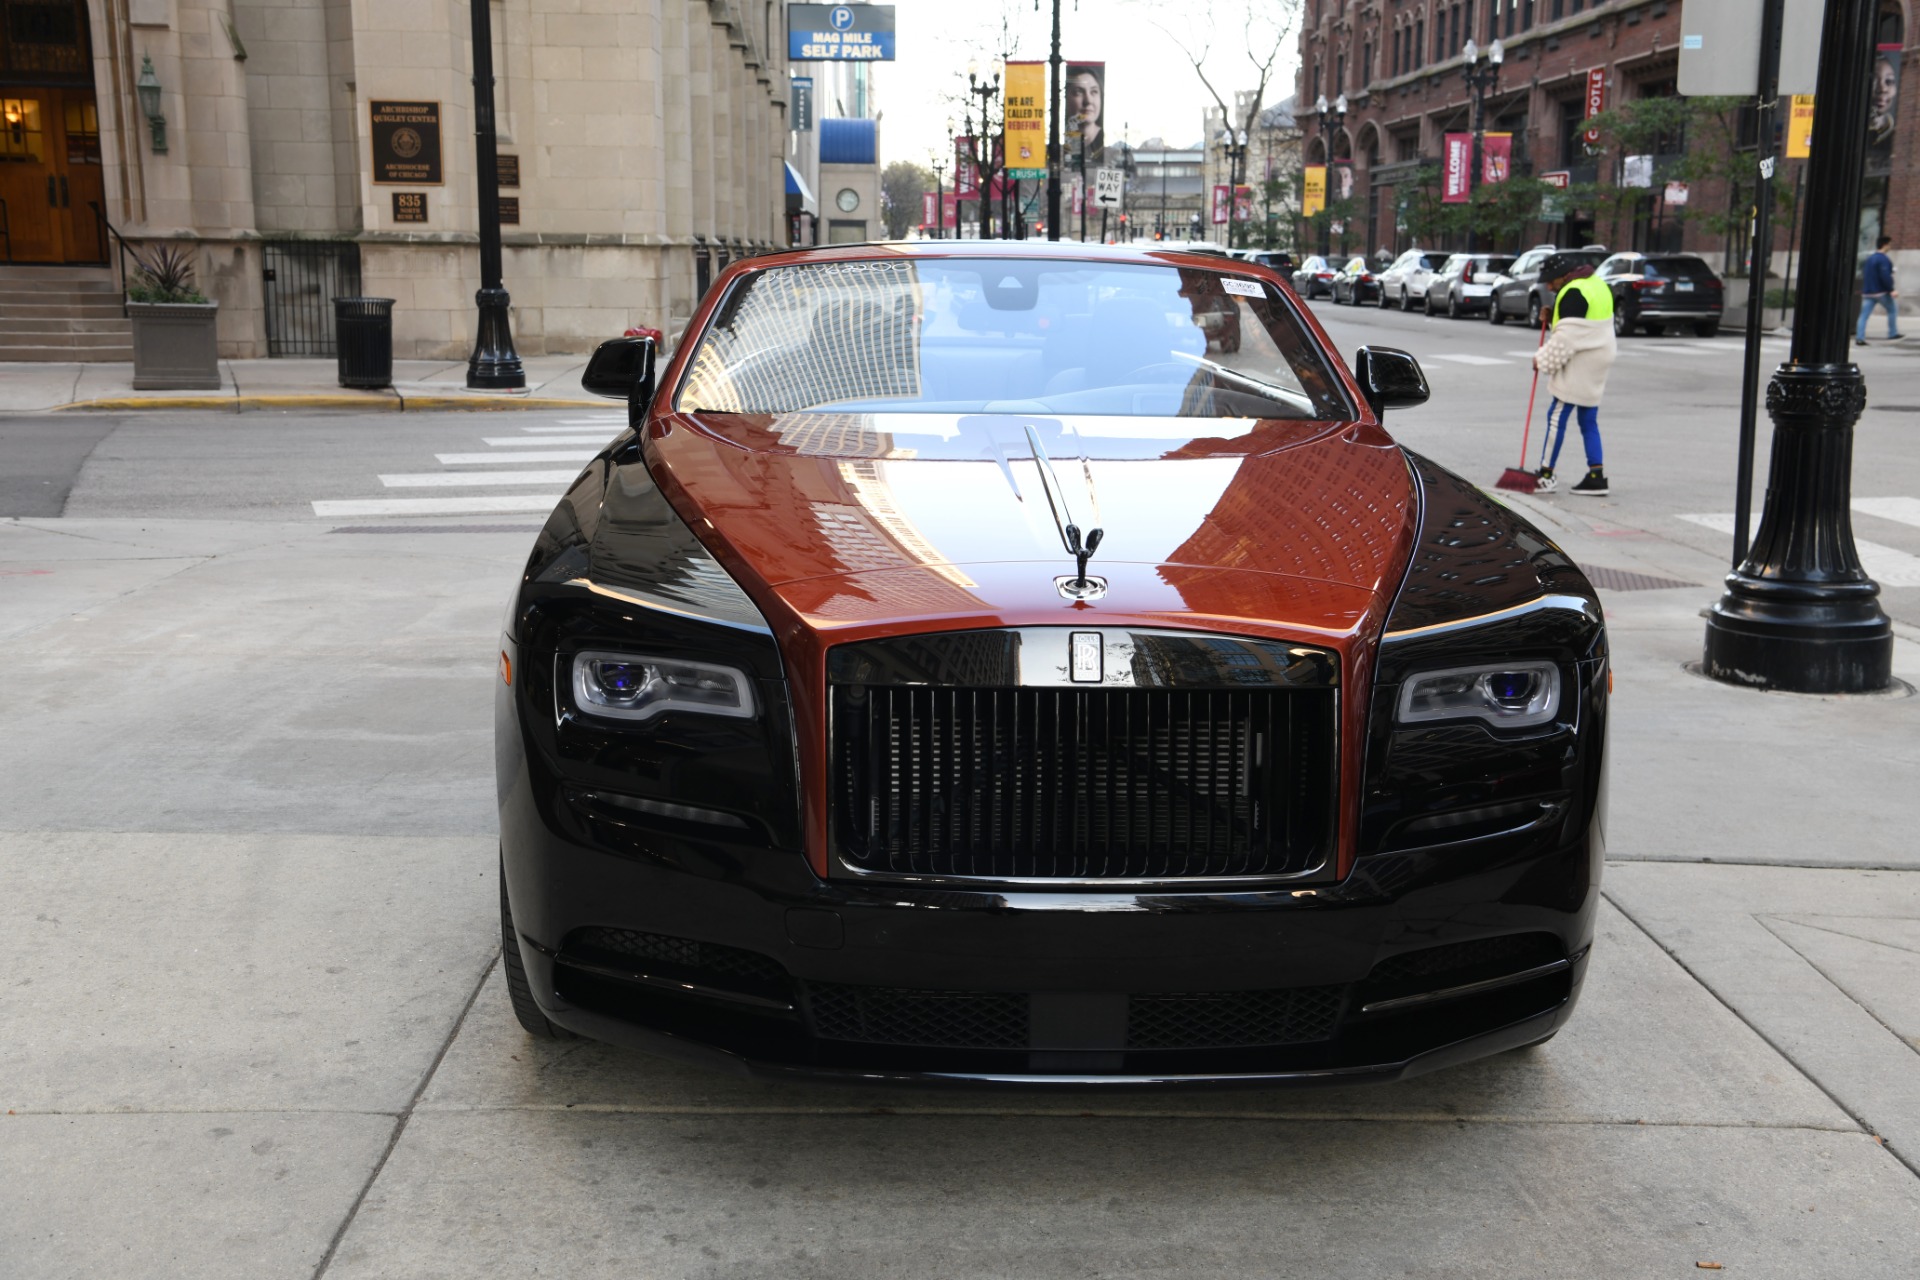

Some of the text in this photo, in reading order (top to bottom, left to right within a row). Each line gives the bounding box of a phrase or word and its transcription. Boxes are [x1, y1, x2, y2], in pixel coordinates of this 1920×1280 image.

[836, 10, 849, 27] P
[812, 32, 872, 43] MAG MILE
[802, 44, 883, 58] SELF PARK
[1008, 97, 1034, 106] WE ARE
[1588, 72, 1603, 140] CPOTLE
[380, 105, 429, 114] ARCHBISHOP
[1008, 109, 1043, 118] CALLED TO
[373, 114, 437, 124] QUIGLEY CENTER
[1008, 121, 1041, 130] REDEFINE
[1448, 141, 1461, 196] WELCOME
[1016, 170, 1037, 179] RUSH
[1099, 171, 1120, 182] ONE
[1098, 183, 1120, 193] WAY
[399, 195, 421, 207] 835
